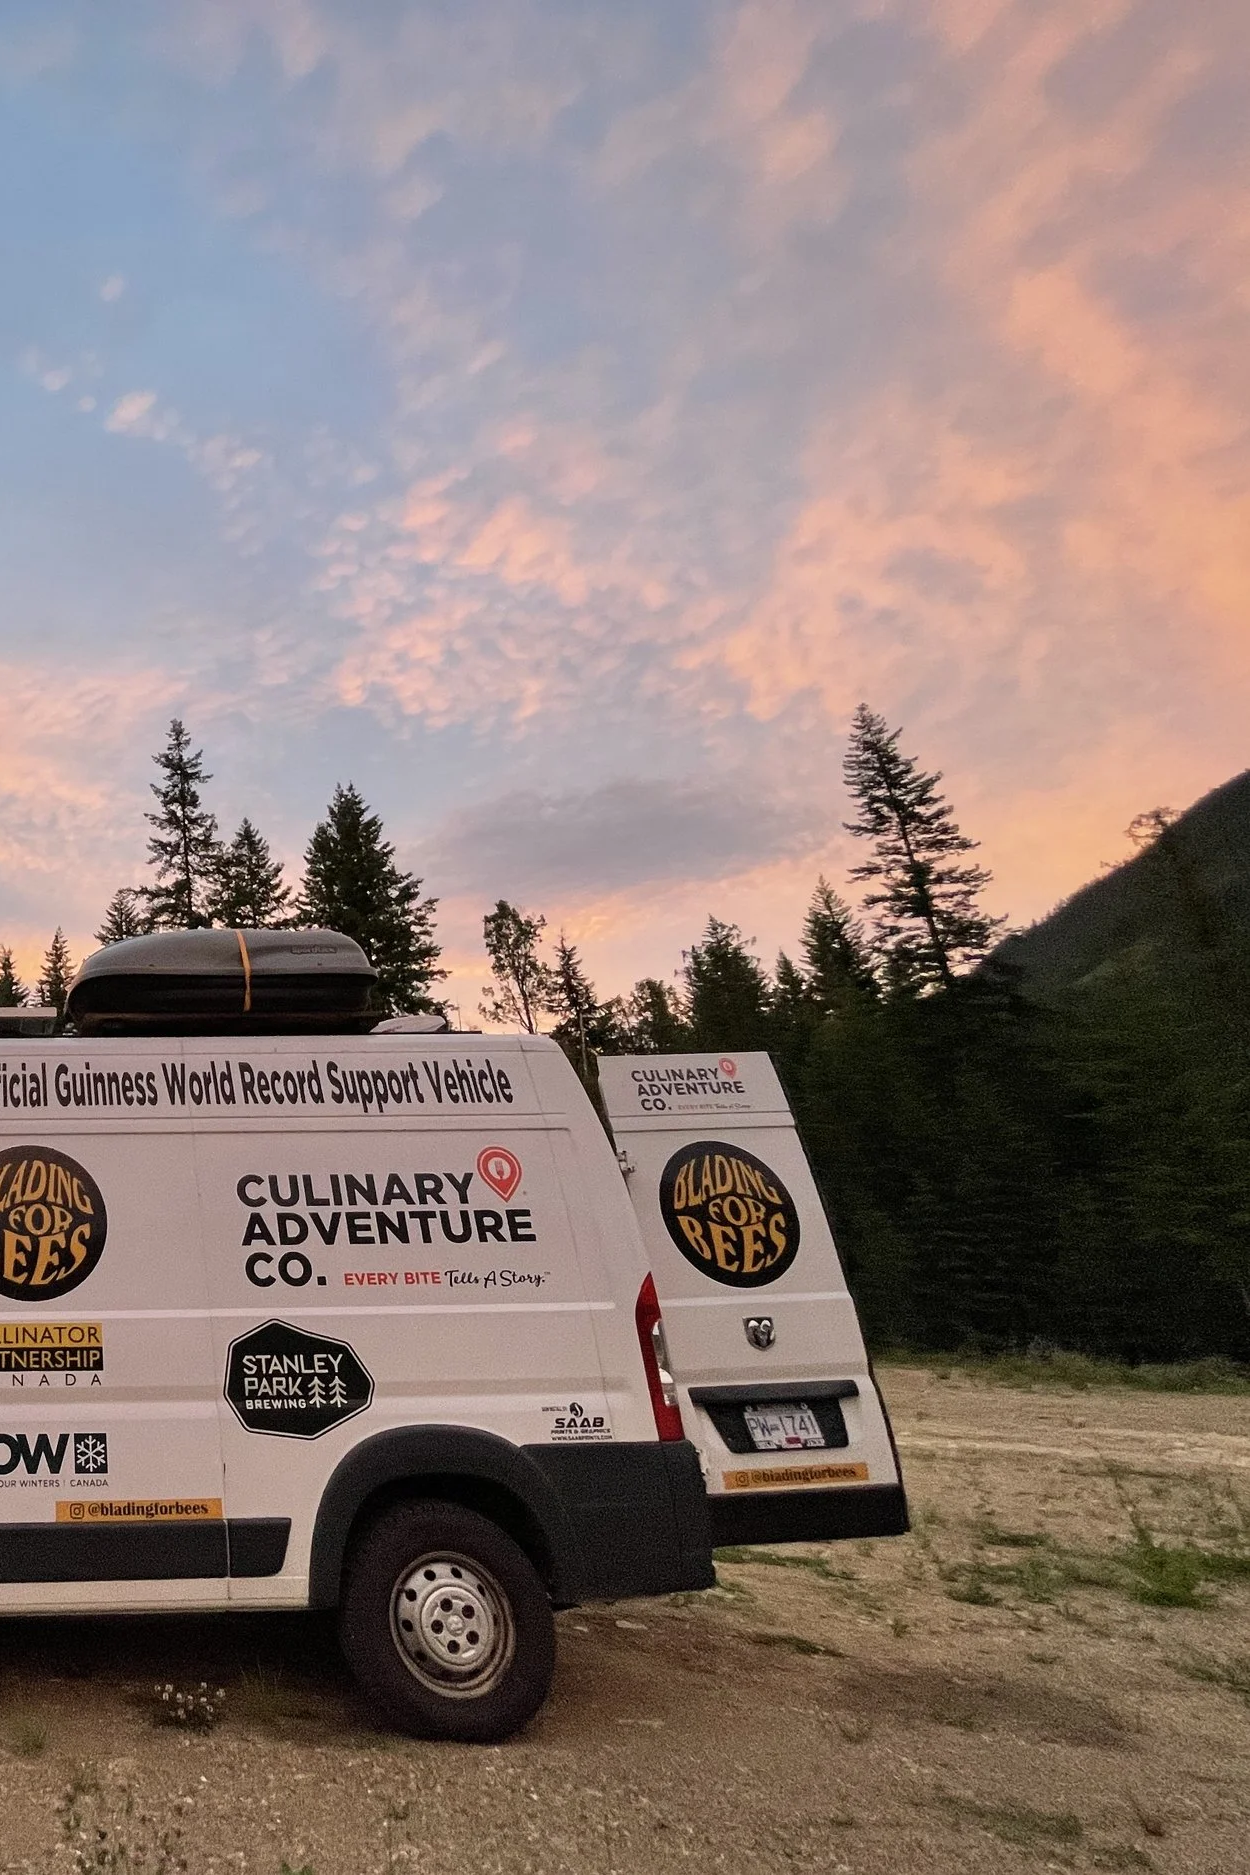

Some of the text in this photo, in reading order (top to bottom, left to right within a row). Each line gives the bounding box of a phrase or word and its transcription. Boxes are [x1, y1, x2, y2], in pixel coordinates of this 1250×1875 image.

[55, 1062, 158, 1107] Guinness
[161, 1060, 236, 1106] World
[238, 1059, 325, 1105] Record
[326, 1060, 426, 1113] Support
[422, 1058, 514, 1104] Vehicle
[631, 1067, 719, 1083] CULINARY
[637, 1081, 745, 1097] ADVENTURE
[640, 1098, 672, 1111] CO.
[236, 1172, 474, 1208] CULINARY
[673, 1154, 783, 1210] BLADING
[8, 1202, 74, 1236] FOR
[708, 1195, 766, 1226] FOR
[241, 1208, 537, 1247] ADVENTURE
[676, 1211, 787, 1273] BEES
[244, 1251, 328, 1288] CO.
[344, 1272, 398, 1286] EVERY
[404, 1271, 442, 1285] BITE
[444, 1269, 479, 1288] Tells
[483, 1270, 497, 1288] A
[242, 1353, 343, 1375] STANLEY
[244, 1376, 304, 1397] PARK
[245, 1399, 307, 1410] BREWING
[554, 1416, 605, 1429] SAAB
[19, 1479, 61, 1488] WINTERS
[69, 1478, 109, 1488] CANADA
[88, 1502, 209, 1519] @bladingforbees
